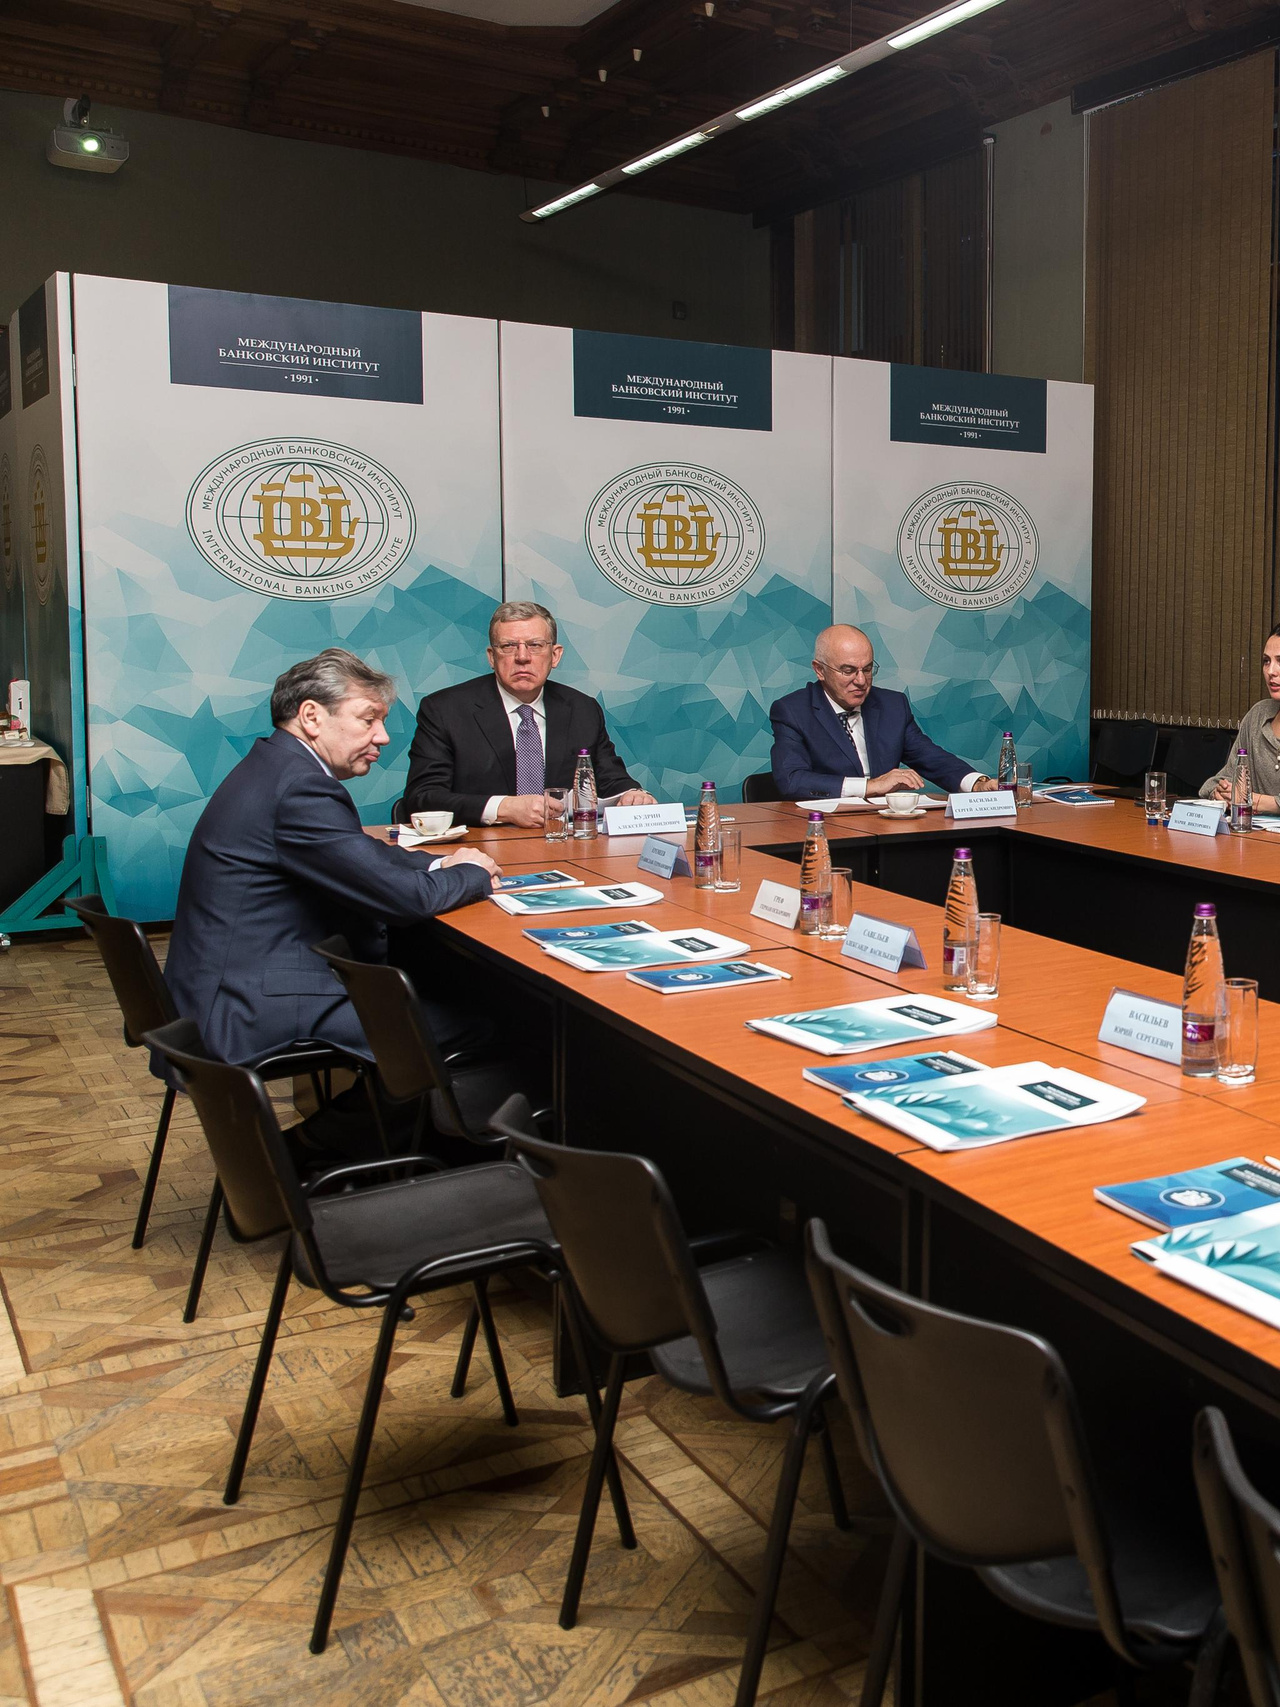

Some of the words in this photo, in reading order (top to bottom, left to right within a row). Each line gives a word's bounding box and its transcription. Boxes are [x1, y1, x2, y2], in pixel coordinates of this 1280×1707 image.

[237, 337, 361, 358] МЕЖДУНАРОДНЫЙ
[218, 348, 310, 366] БАНКОВСКИЙ
[312, 357, 380, 372] ИНСТИТУТ
[611, 384, 683, 399] БАНКОВСКИЙ
[685, 391, 738, 404] ИНСТИТУТ
[626, 374, 724, 391] МЕЖДУНАРОДНЫЙ
[920, 412, 976, 424] БАНКОВСКИЙ
[977, 418, 1020, 430] ИНСТИТУТ
[931, 403, 1009, 418] МЕЖДУНАРОДНЫЙ
[202, 444, 285, 511] МЕЖДУНАРОДНЫЙ
[288, 445, 367, 473] БАНКОВСКИЙ
[367, 469, 403, 519] ИНСТИТУТ
[597, 468, 662, 528] МЕЖДУНАРОДНЫЙ
[665, 469, 728, 493] БАНКОВСКИЙ
[726, 491, 755, 534] ИНСТИТУТ
[906, 487, 959, 540] МЕЖДУНАРОДНЫЙ
[961, 487, 1010, 508] БАНКОВСКИЙ
[1009, 506, 1032, 545] ИНСТИТУТ
[202, 529, 288, 593] INTERNATIONAL
[295, 580, 354, 595] BANKING
[357, 536, 403, 584] INSTITUTE
[597, 544, 664, 600] INTERNATIONAL
[669, 587, 716, 601] BANKING
[719, 549, 755, 592] INSTITUTE
[906, 555, 958, 604] INTERNATIONAL
[962, 594, 1000, 606] BANKING
[1002, 559, 1032, 597] INSTITUTE
[1128, 1010, 1169, 1029] ВАСИЛЬЕВ
[1113, 1025, 1134, 1037] ЮРИЙ
[1135, 1032, 1174, 1050] СЕРГЕЕВИЧ
